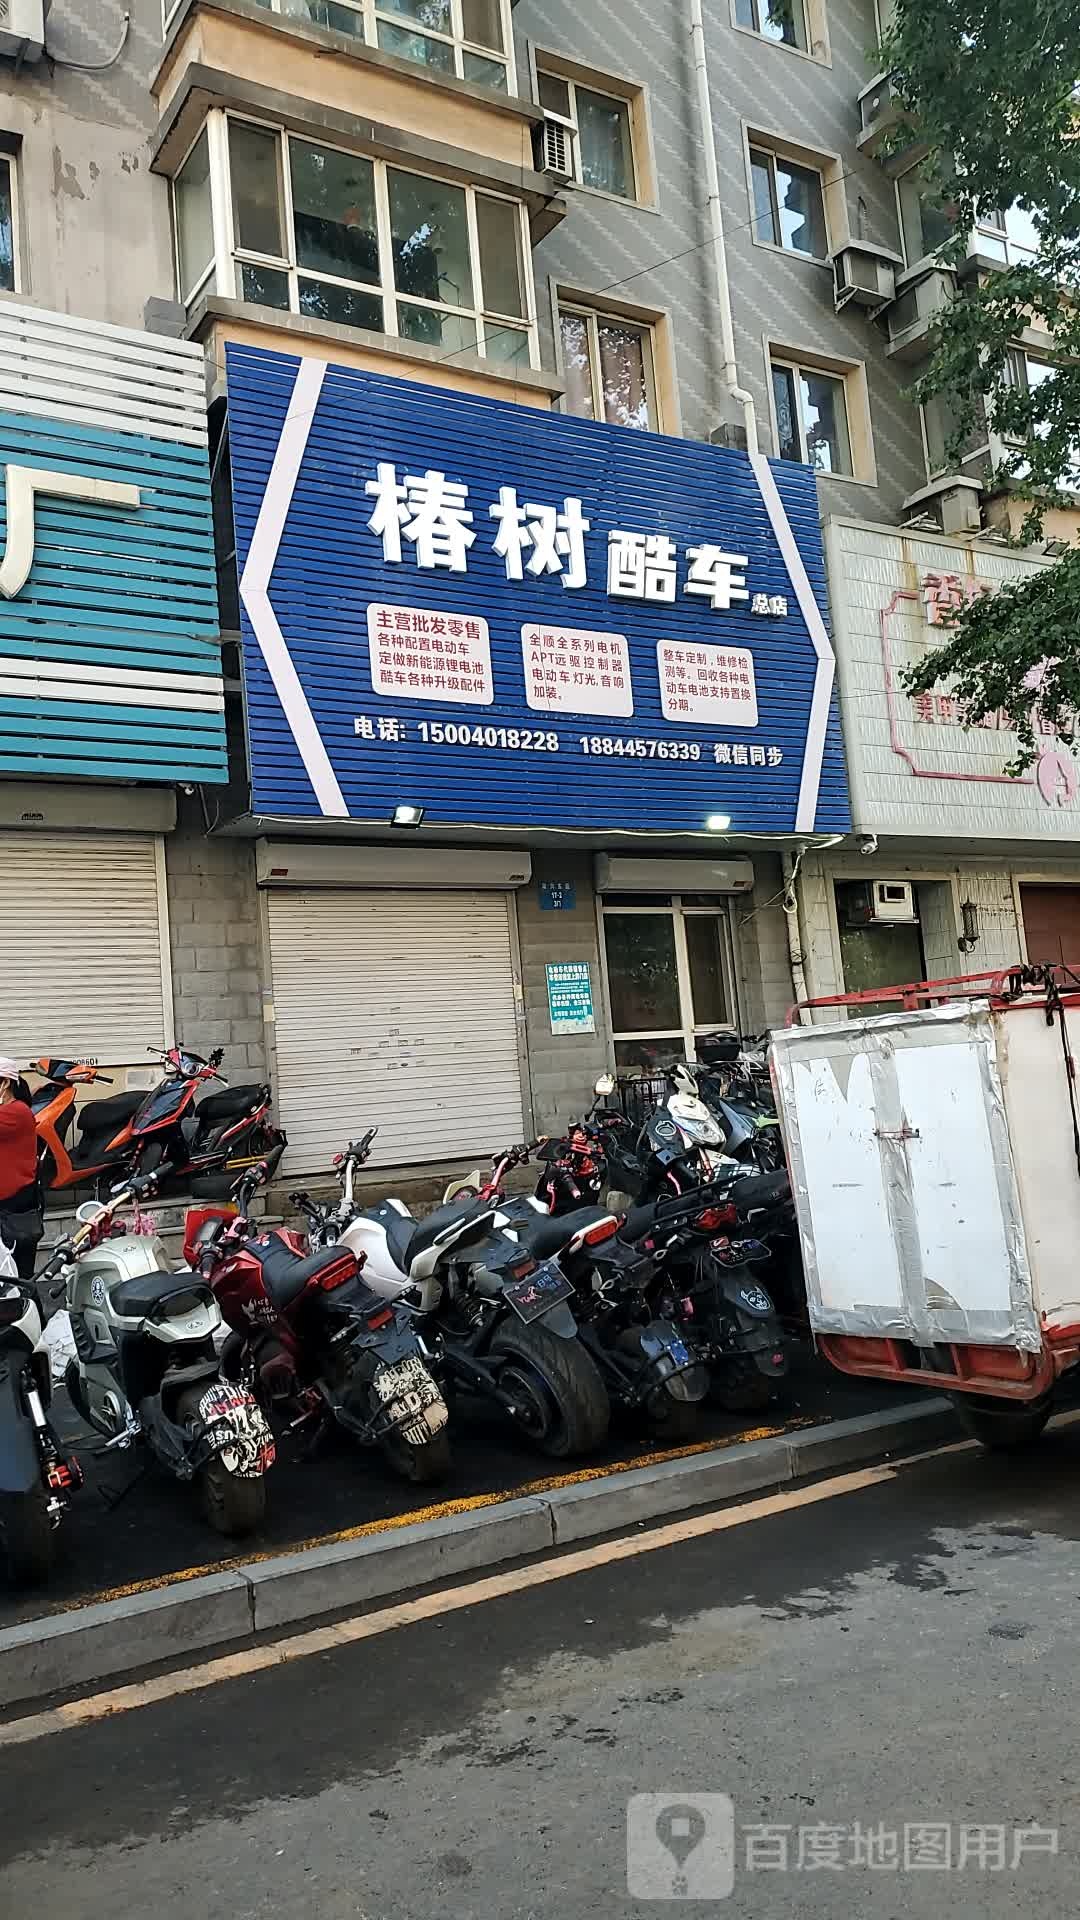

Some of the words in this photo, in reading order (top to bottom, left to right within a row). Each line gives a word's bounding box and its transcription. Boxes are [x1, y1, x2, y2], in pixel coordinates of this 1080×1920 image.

[365, 462, 750, 610] 椿树酷车
[751, 593, 788, 617] 总店
[376, 610, 481, 640] 主营批发零售
[377, 632, 470, 656] 各种配置电动车
[529, 633, 622, 655] 全顺全系列电机
[378, 651, 485, 675] 定做新能源锂电池
[531, 651, 623, 673] APT远驱控制器
[380, 669, 486, 693] 酷车各种升级配件
[533, 685, 562, 700] 加装。
[666, 681, 752, 701] 动车电池支持置换
[668, 697, 694, 712] 分期。
[417, 722, 560, 751] 15004018228
[579, 736, 700, 761] 18844576339
[713, 743, 784, 767] 微信同步
